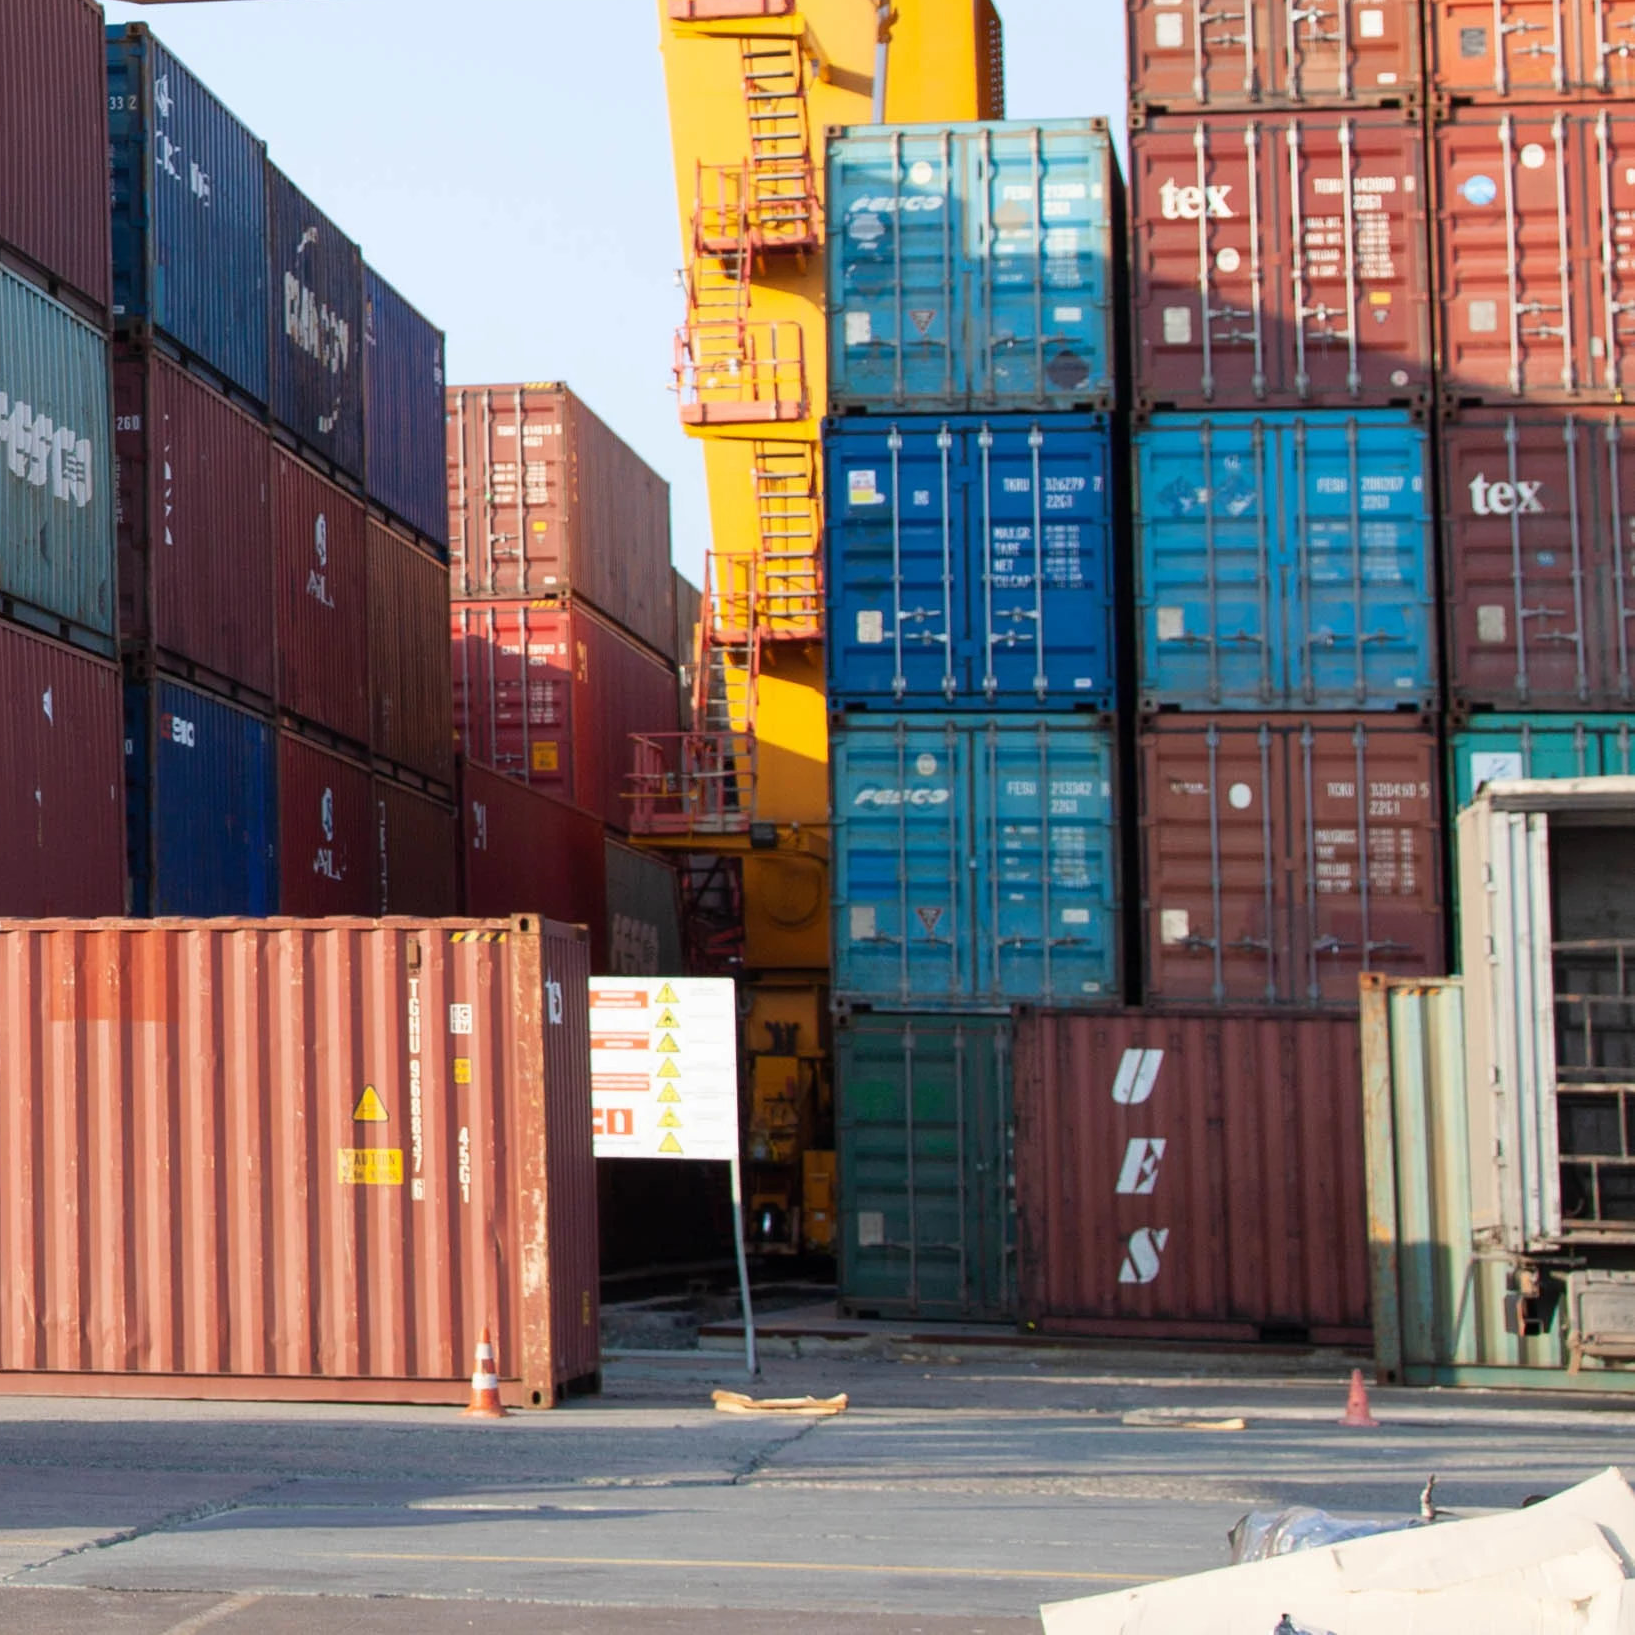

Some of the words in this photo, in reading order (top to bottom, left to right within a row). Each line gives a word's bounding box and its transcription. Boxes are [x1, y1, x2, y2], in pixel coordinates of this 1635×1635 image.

[849, 195, 944, 213] FESCO
[1468, 472, 1544, 515] tex
[993, 543, 1021, 557] TARE
[993, 559, 1014, 572] NET
[854, 788, 950, 805] FESCO
[1007, 781, 1036, 796] FESU
[1368, 801, 1401, 816] 22G1
[407, 978, 422, 1054] TGHU
[458, 1126, 472, 1204] 45G1
